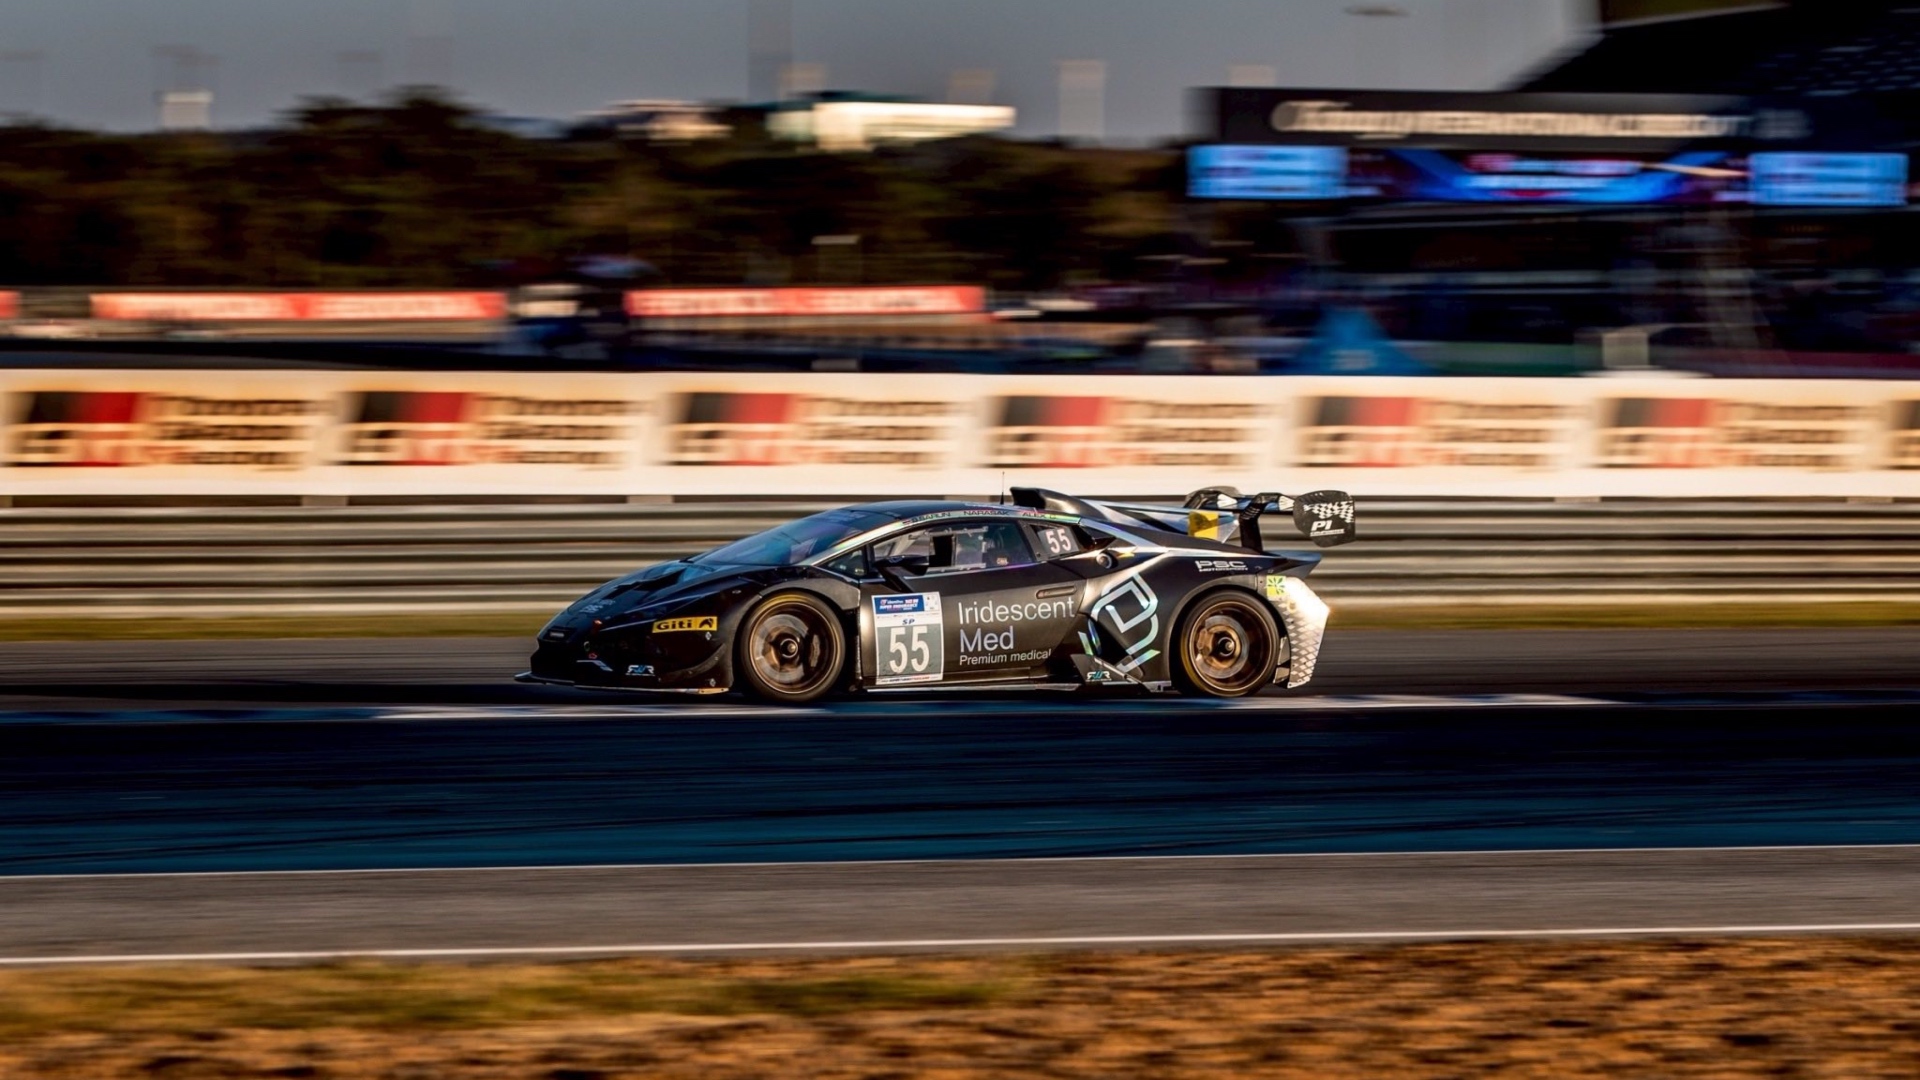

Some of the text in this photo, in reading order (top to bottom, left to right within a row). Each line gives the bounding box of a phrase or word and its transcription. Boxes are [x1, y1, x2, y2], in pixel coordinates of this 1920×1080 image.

[1046, 528, 1071, 554] 55
[958, 596, 1076, 625] Iridescent
[656, 619, 693, 630] Giti
[889, 625, 930, 674] 55
[960, 625, 1015, 653] Med
[959, 648, 1052, 666] Premium medical
